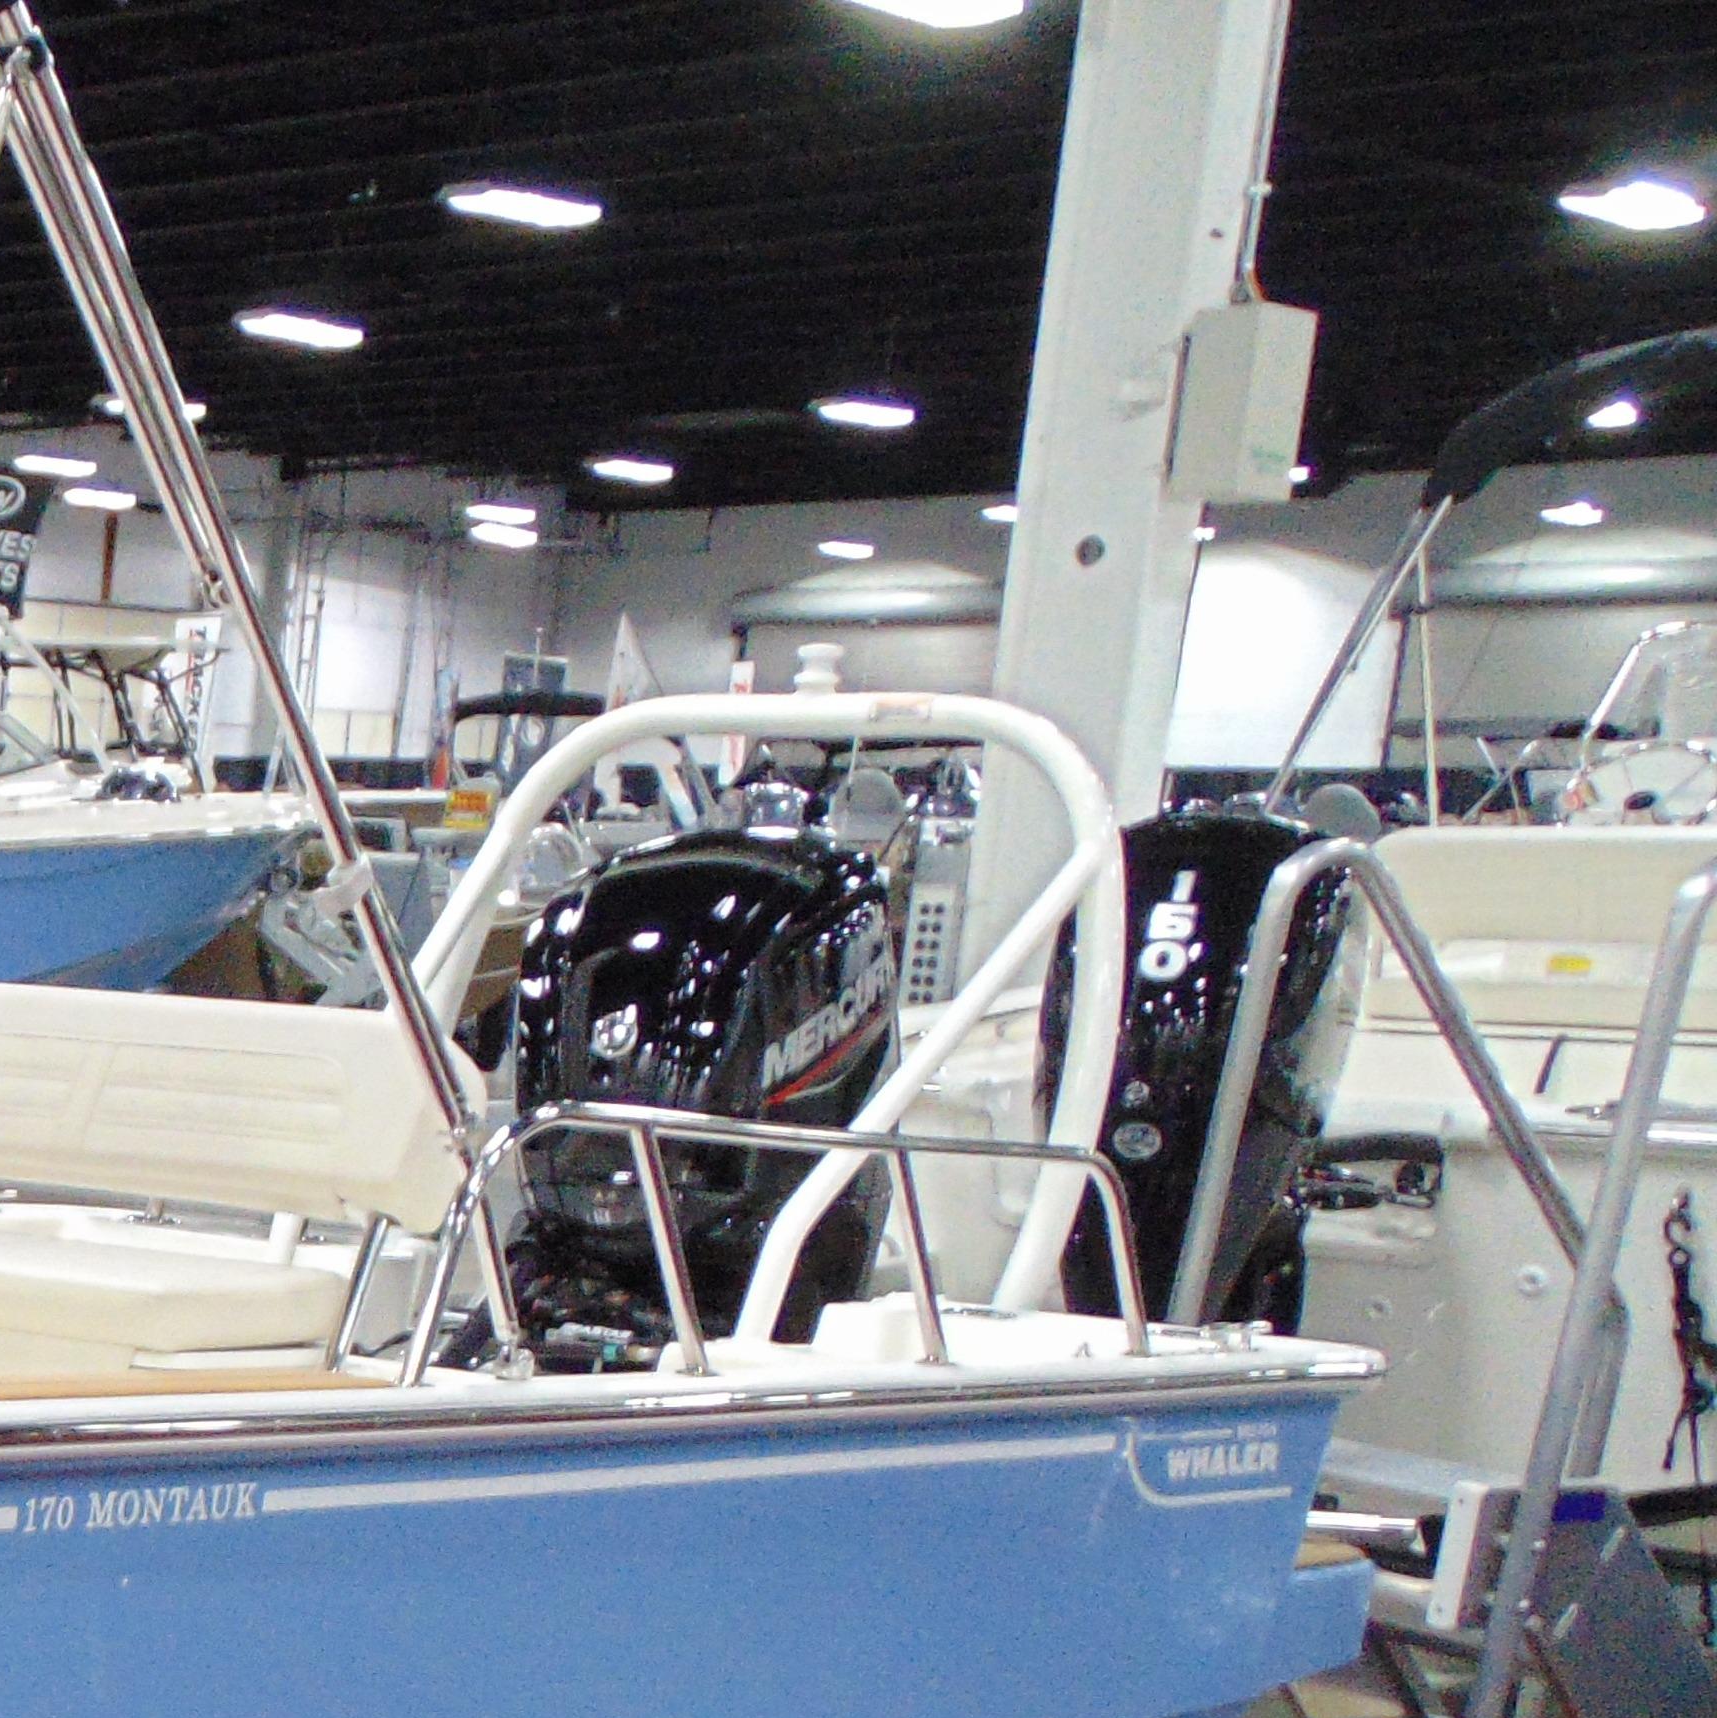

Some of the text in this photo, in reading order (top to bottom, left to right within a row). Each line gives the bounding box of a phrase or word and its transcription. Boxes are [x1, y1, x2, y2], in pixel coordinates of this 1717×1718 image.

[1138, 869, 1197, 982] 150
[1167, 1441, 1279, 1481] WHALER
[23, 1482, 257, 1532] 170 MONTAUK
